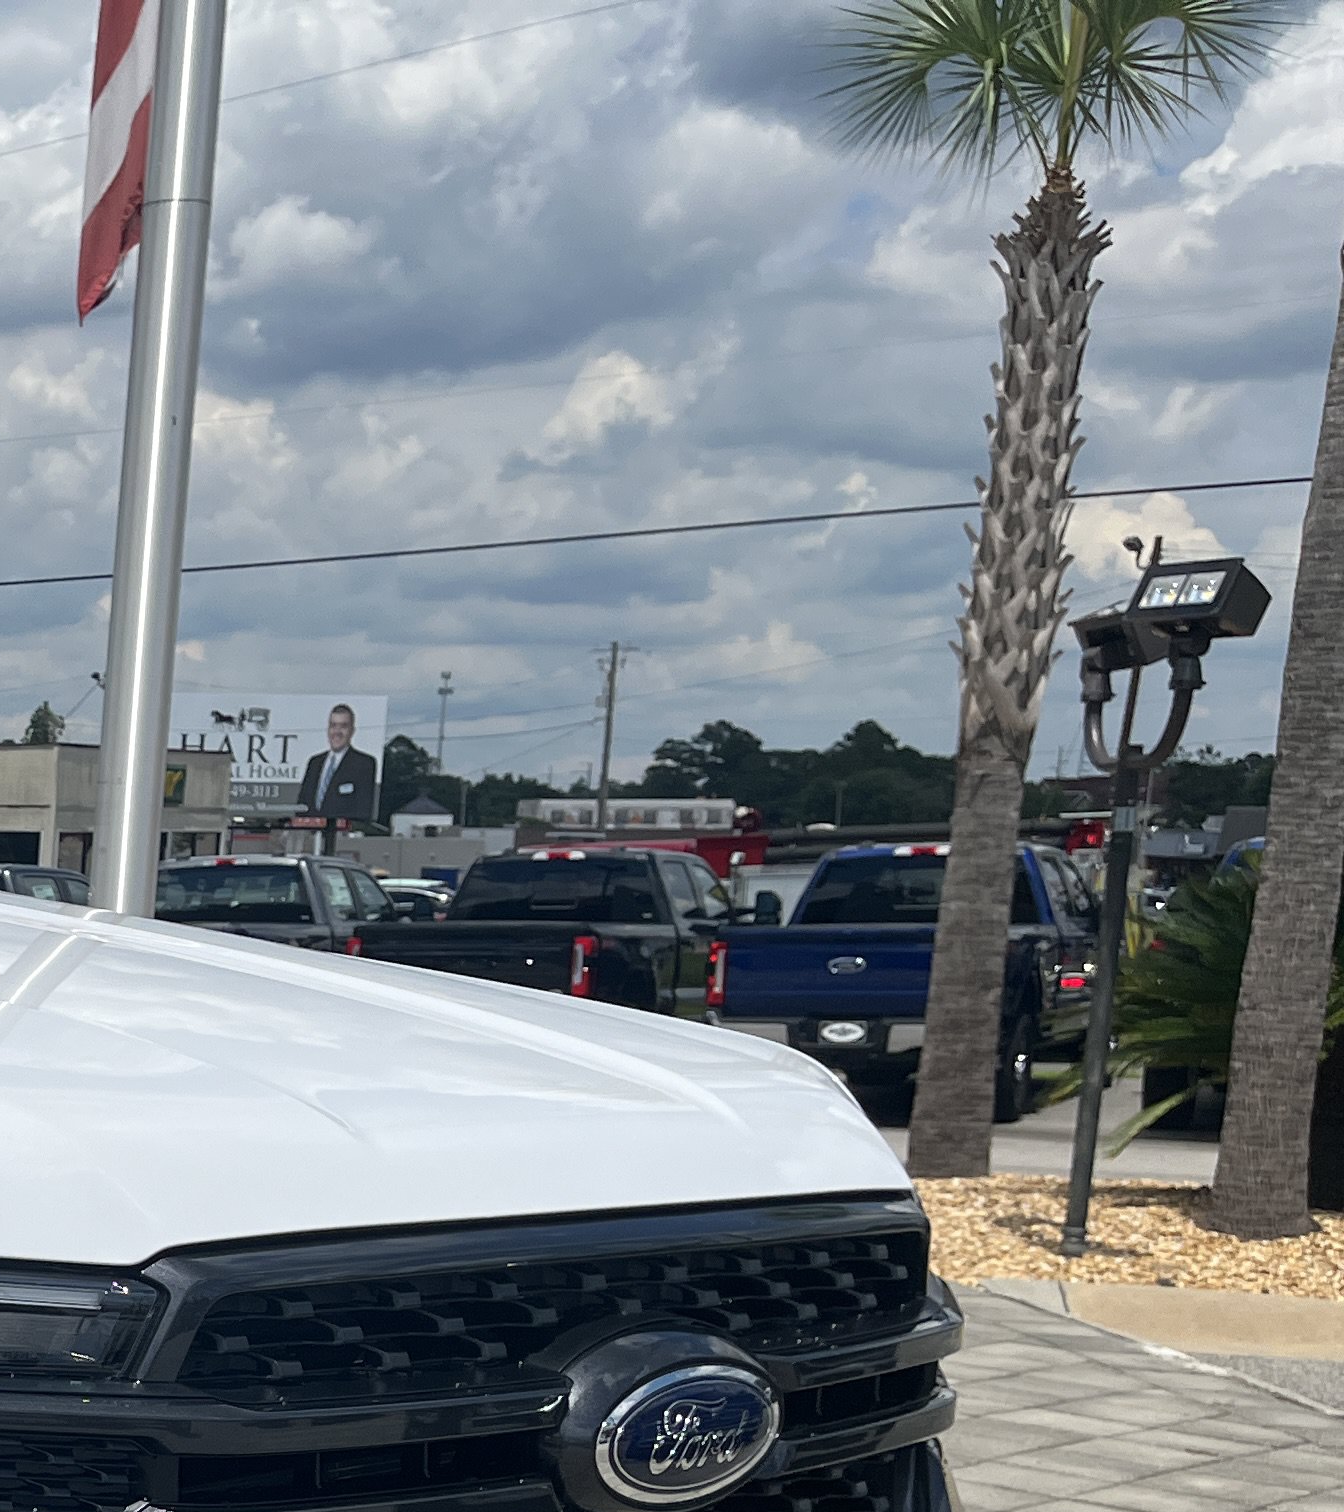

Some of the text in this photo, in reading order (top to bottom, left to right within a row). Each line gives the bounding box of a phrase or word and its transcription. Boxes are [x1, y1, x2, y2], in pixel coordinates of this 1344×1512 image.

[181, 733, 298, 763] HART
[249, 764, 299, 779] HOME
[647, 1395, 750, 1476] Ford
